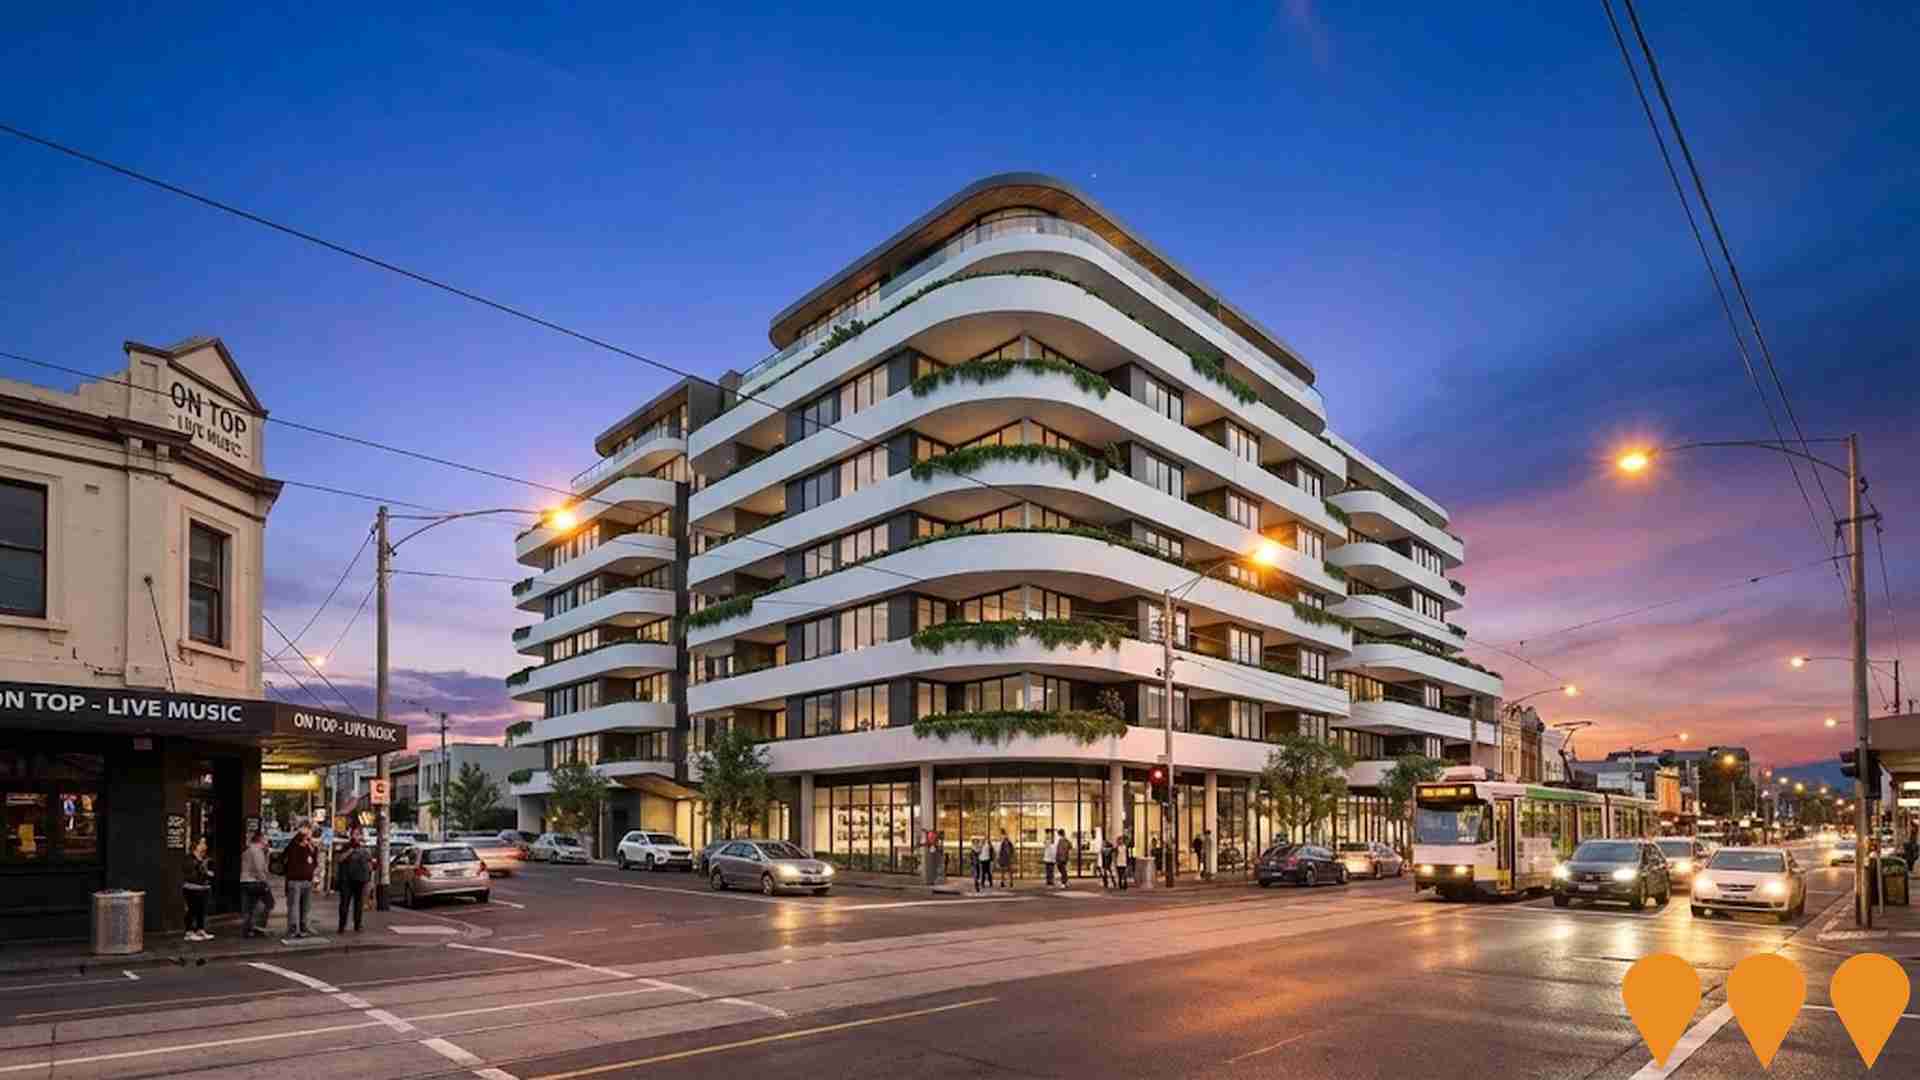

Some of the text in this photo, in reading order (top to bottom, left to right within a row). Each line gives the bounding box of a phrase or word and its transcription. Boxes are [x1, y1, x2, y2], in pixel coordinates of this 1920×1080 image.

[172, 382, 246, 439] ON TOP
[0, 690, 24, 709] N
[31, 692, 85, 712] TOP
[108, 697, 161, 717] LIVE
[168, 701, 242, 722] MUSIC
[294, 712, 313, 728] ON
[315, 716, 338, 733] TOP
